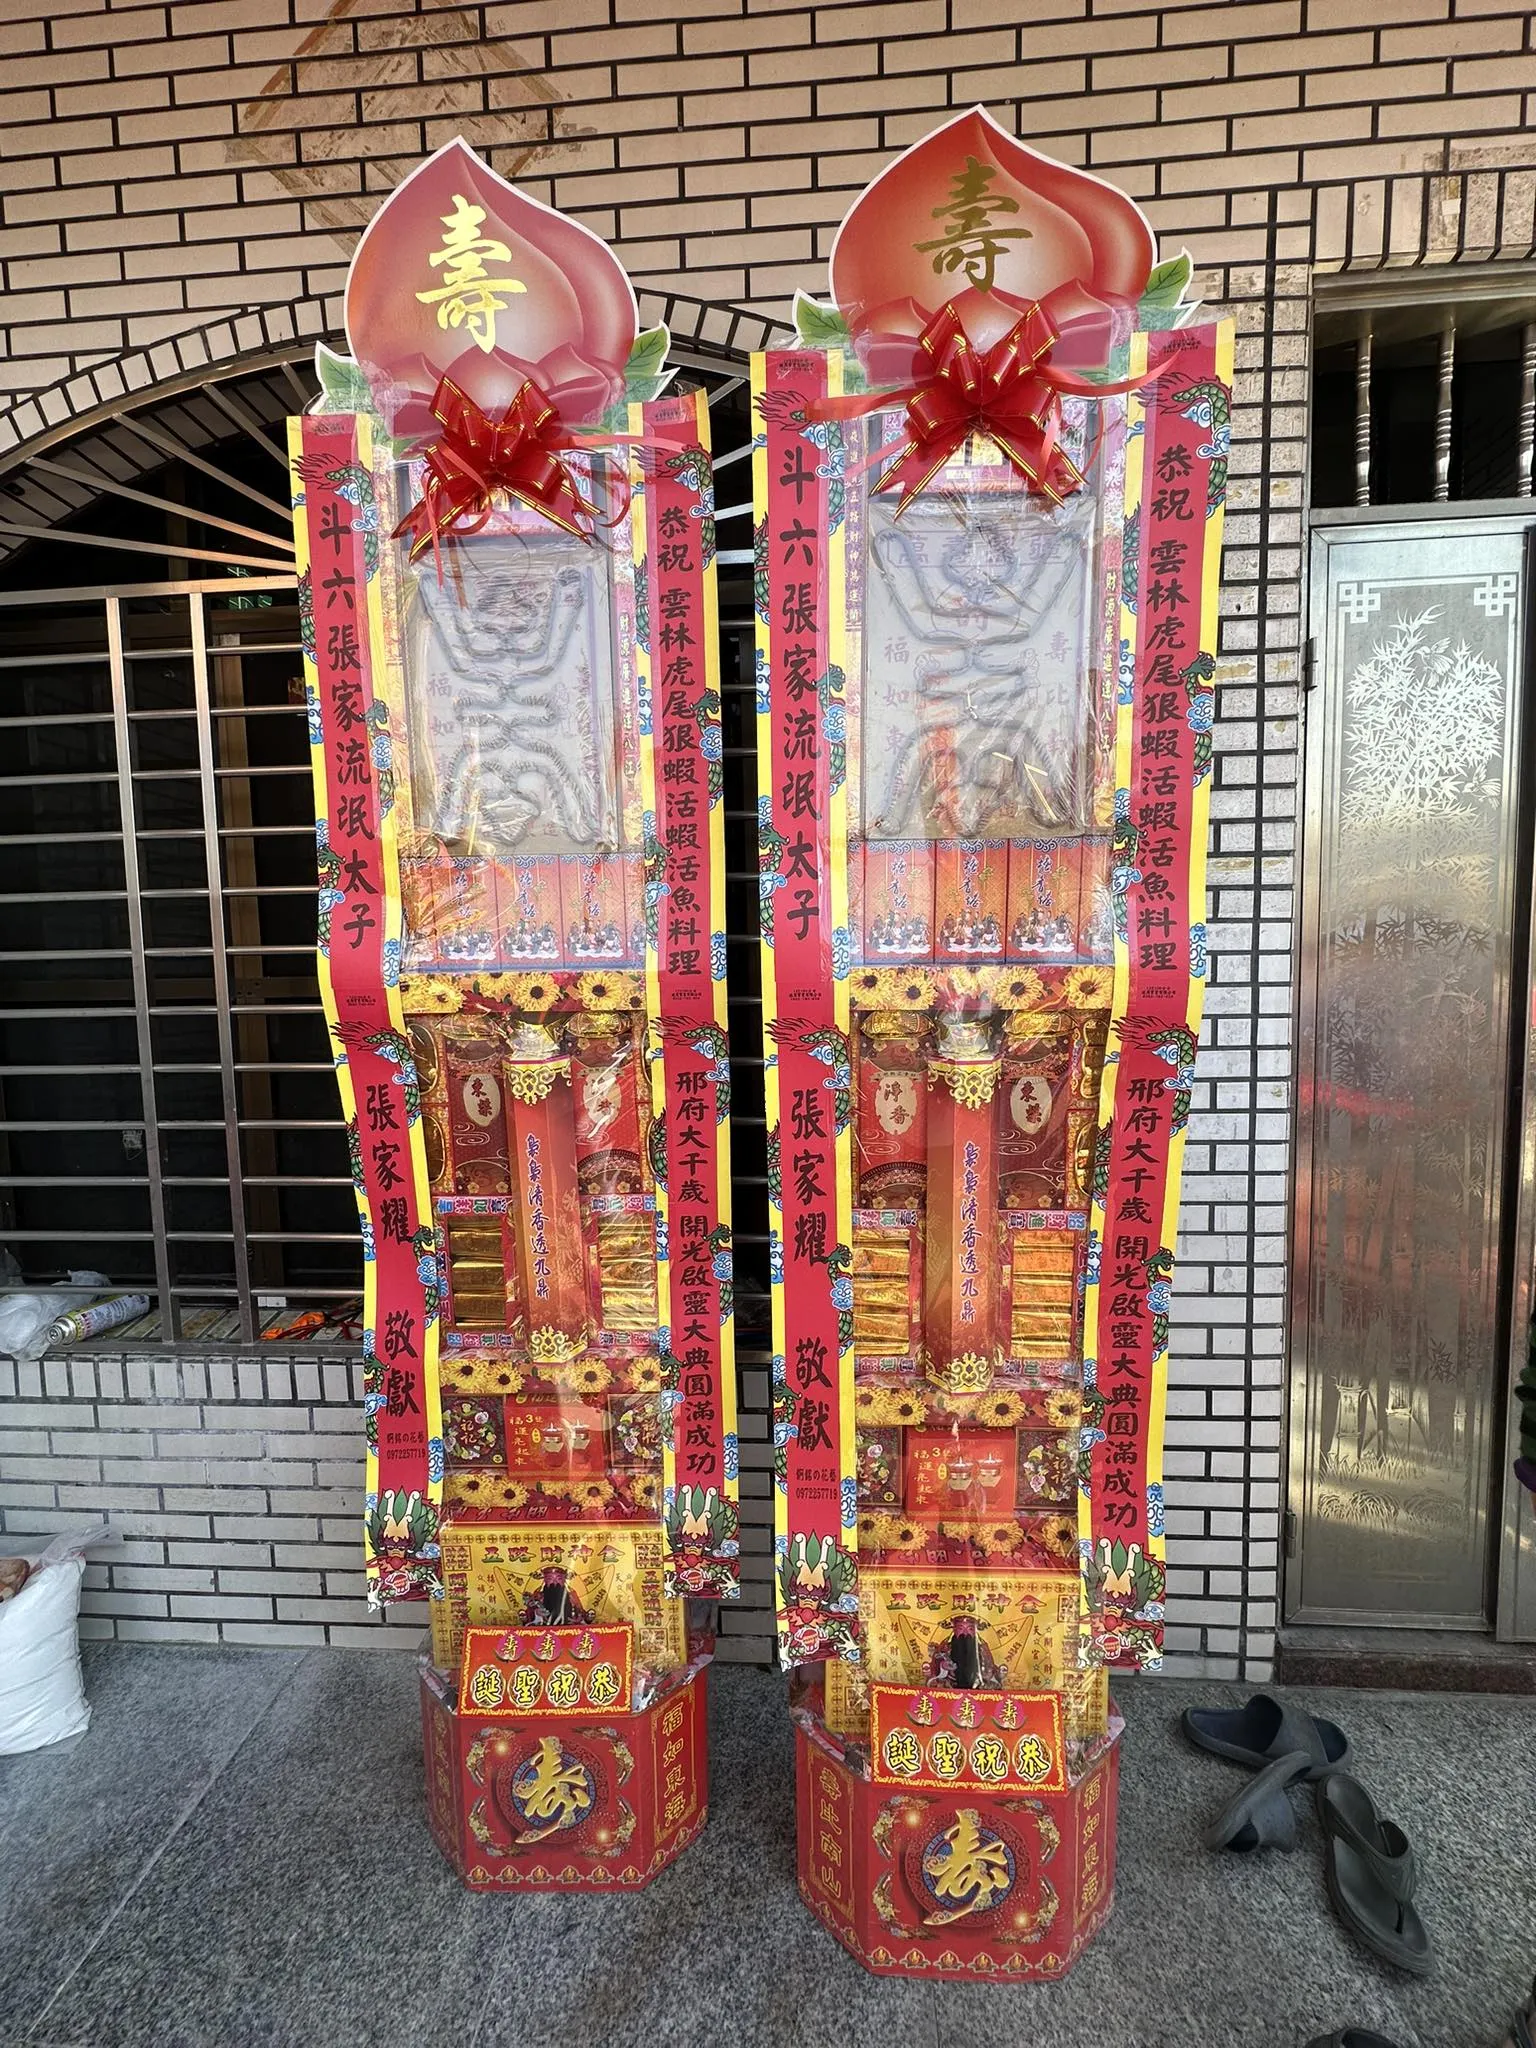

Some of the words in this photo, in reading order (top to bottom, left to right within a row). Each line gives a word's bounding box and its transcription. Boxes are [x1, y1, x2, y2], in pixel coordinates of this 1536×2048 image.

[416, 194, 527, 353] 壽
[913, 156, 1032, 292] 壽
[657, 508, 694, 572] 恭祝
[1151, 444, 1194, 522] 恭祝
[319, 502, 379, 949] 斗六張家流氓太子
[780, 446, 823, 941] 斗六張家流氓太子
[366, 1083, 411, 1245] 張家耀
[791, 1088, 828, 1266] 張家耀
[384, 1309, 420, 1416] 敬獻
[796, 1336, 833, 1452] 敬獻
[854, 1357, 916, 1374] 財進寶
[482, 1544, 625, 1563] 五路財神金
[886, 1592, 1047, 1614] 五路財神金
[662, 1701, 686, 1827] 福如東海
